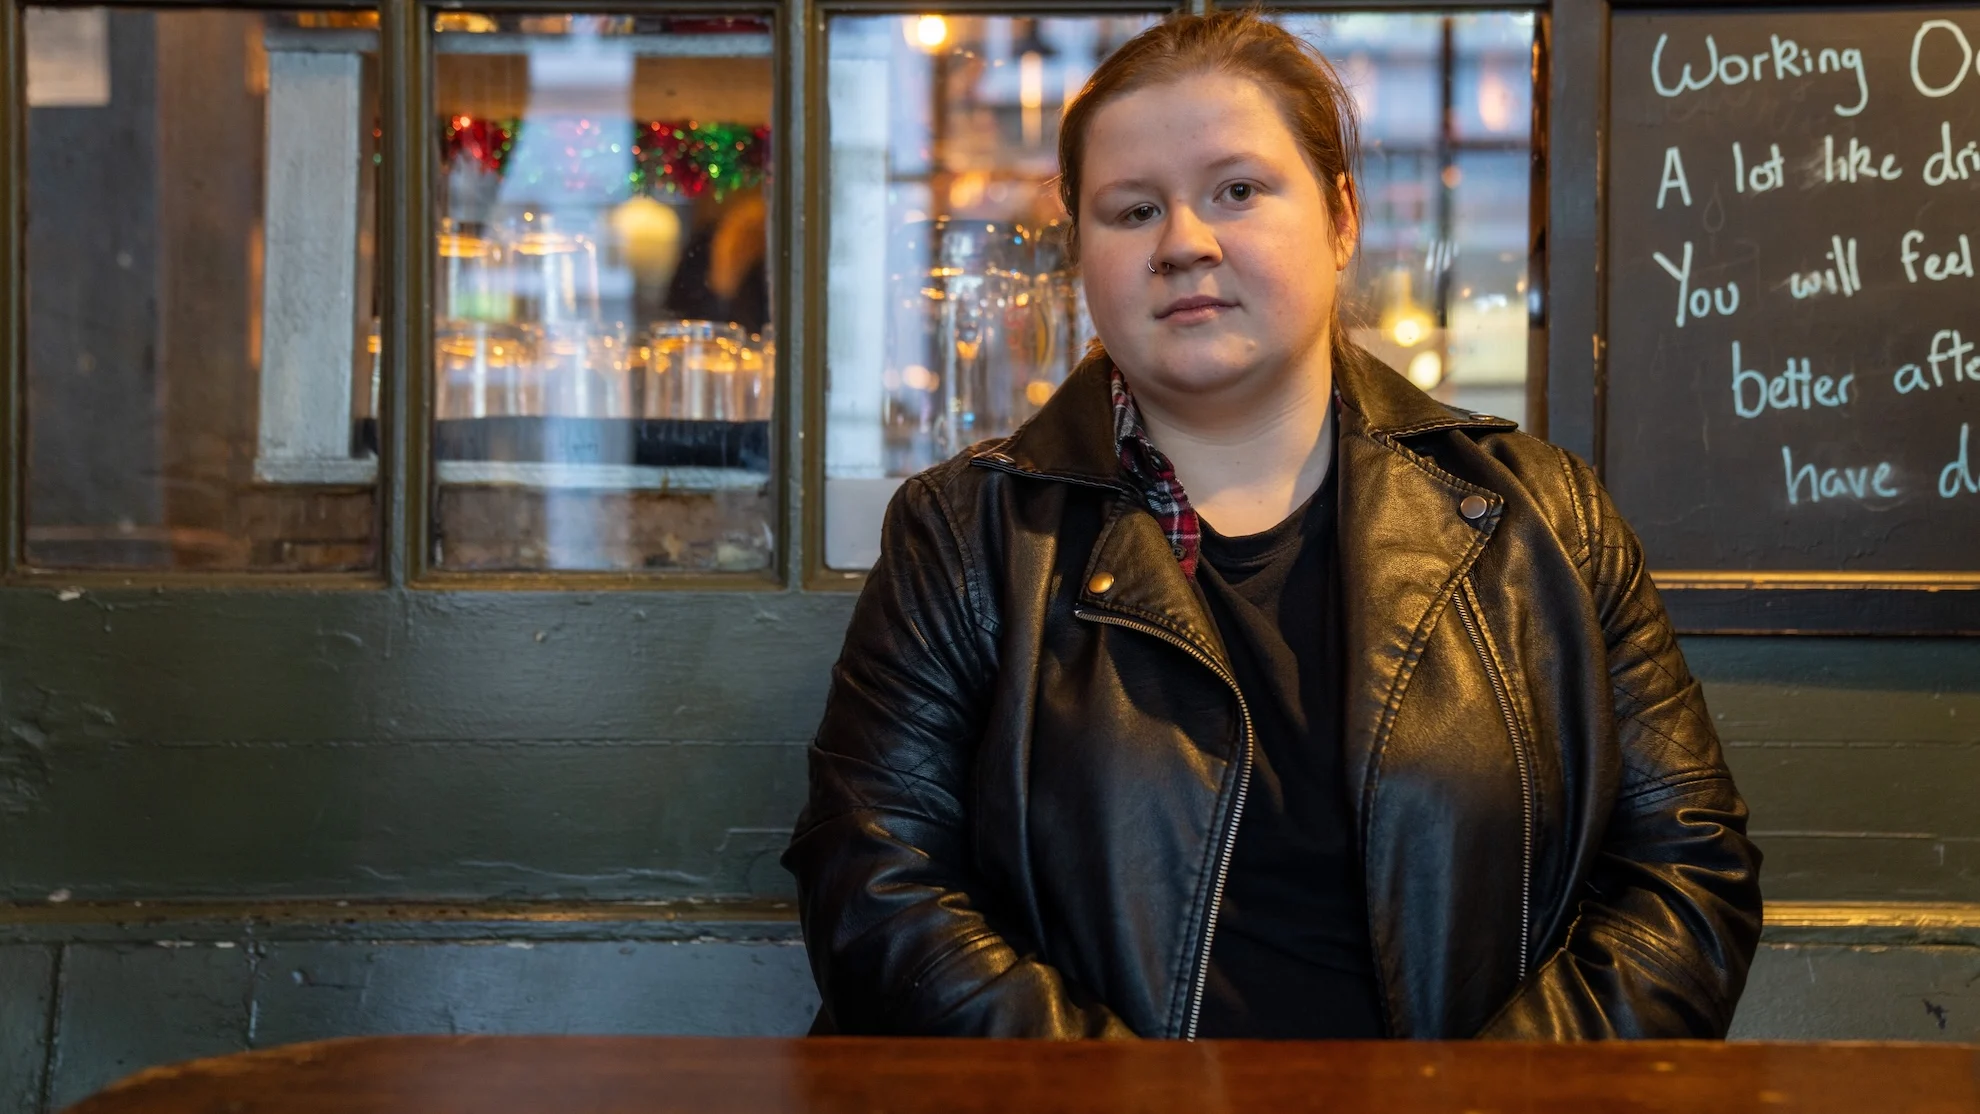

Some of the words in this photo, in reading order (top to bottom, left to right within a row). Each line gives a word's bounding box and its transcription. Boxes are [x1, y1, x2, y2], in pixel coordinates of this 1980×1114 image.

[1651, 33, 1868, 116] Working
[1910, 19, 1980, 97] O
[1656, 146, 1692, 209] A
[1732, 141, 1785, 193] lot
[1824, 134, 1902, 183] like
[1652, 241, 1740, 328] You
[1791, 234, 1861, 297] will
[1901, 229, 1974, 283] feel
[1732, 340, 1854, 418] better
[1781, 445, 1898, 505] have
[1938, 422, 1980, 498] d
